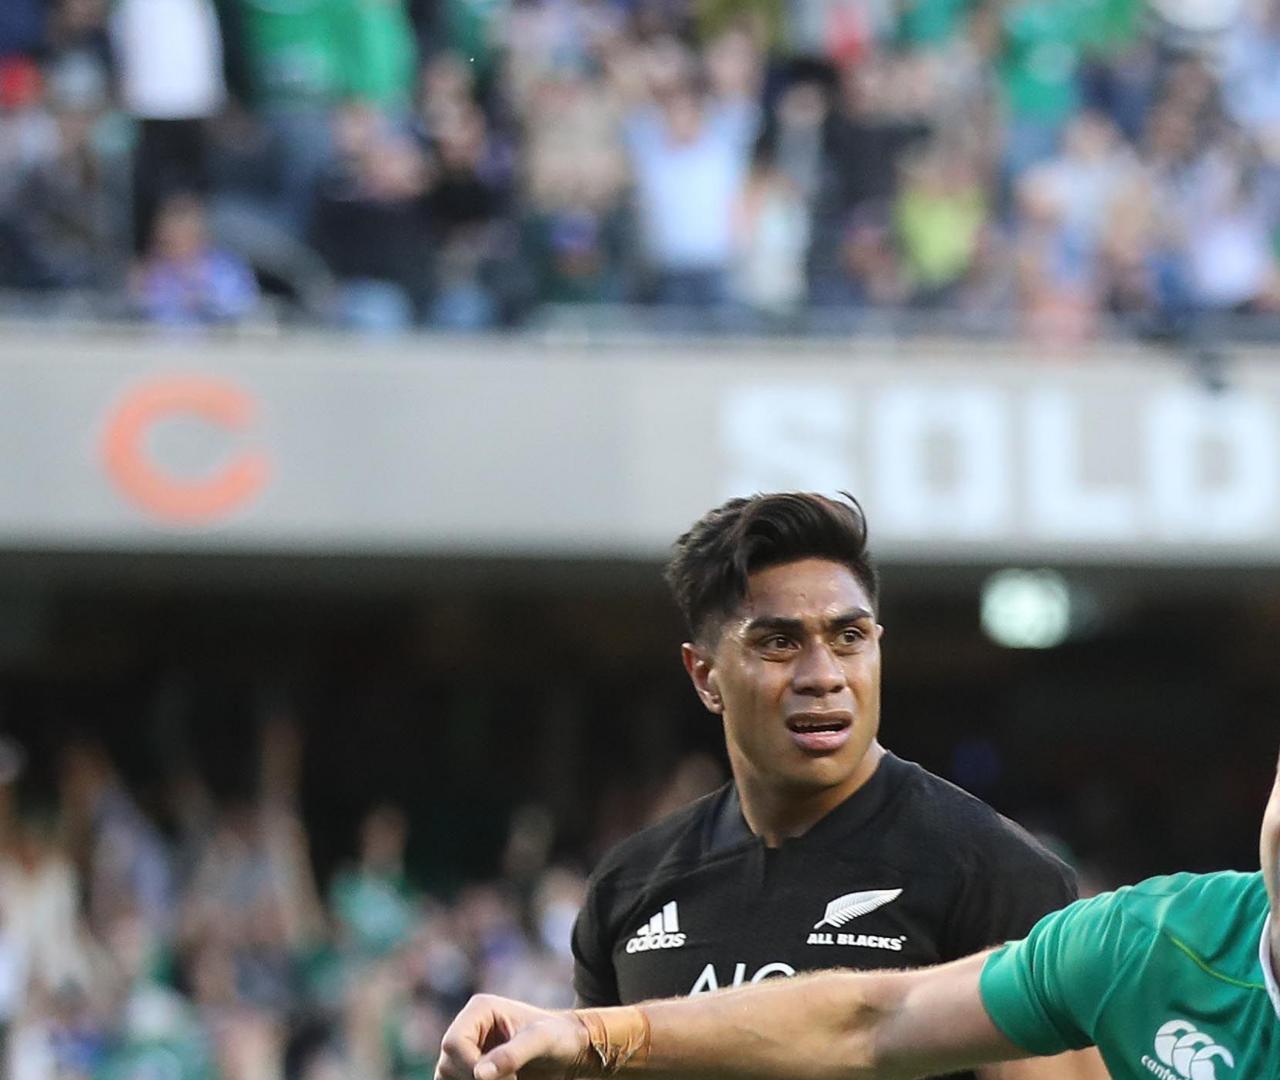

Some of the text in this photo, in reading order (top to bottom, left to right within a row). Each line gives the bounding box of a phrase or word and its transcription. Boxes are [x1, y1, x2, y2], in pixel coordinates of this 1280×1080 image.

[626, 931, 687, 953] adidas
[806, 932, 903, 952] ALL BLACKS
